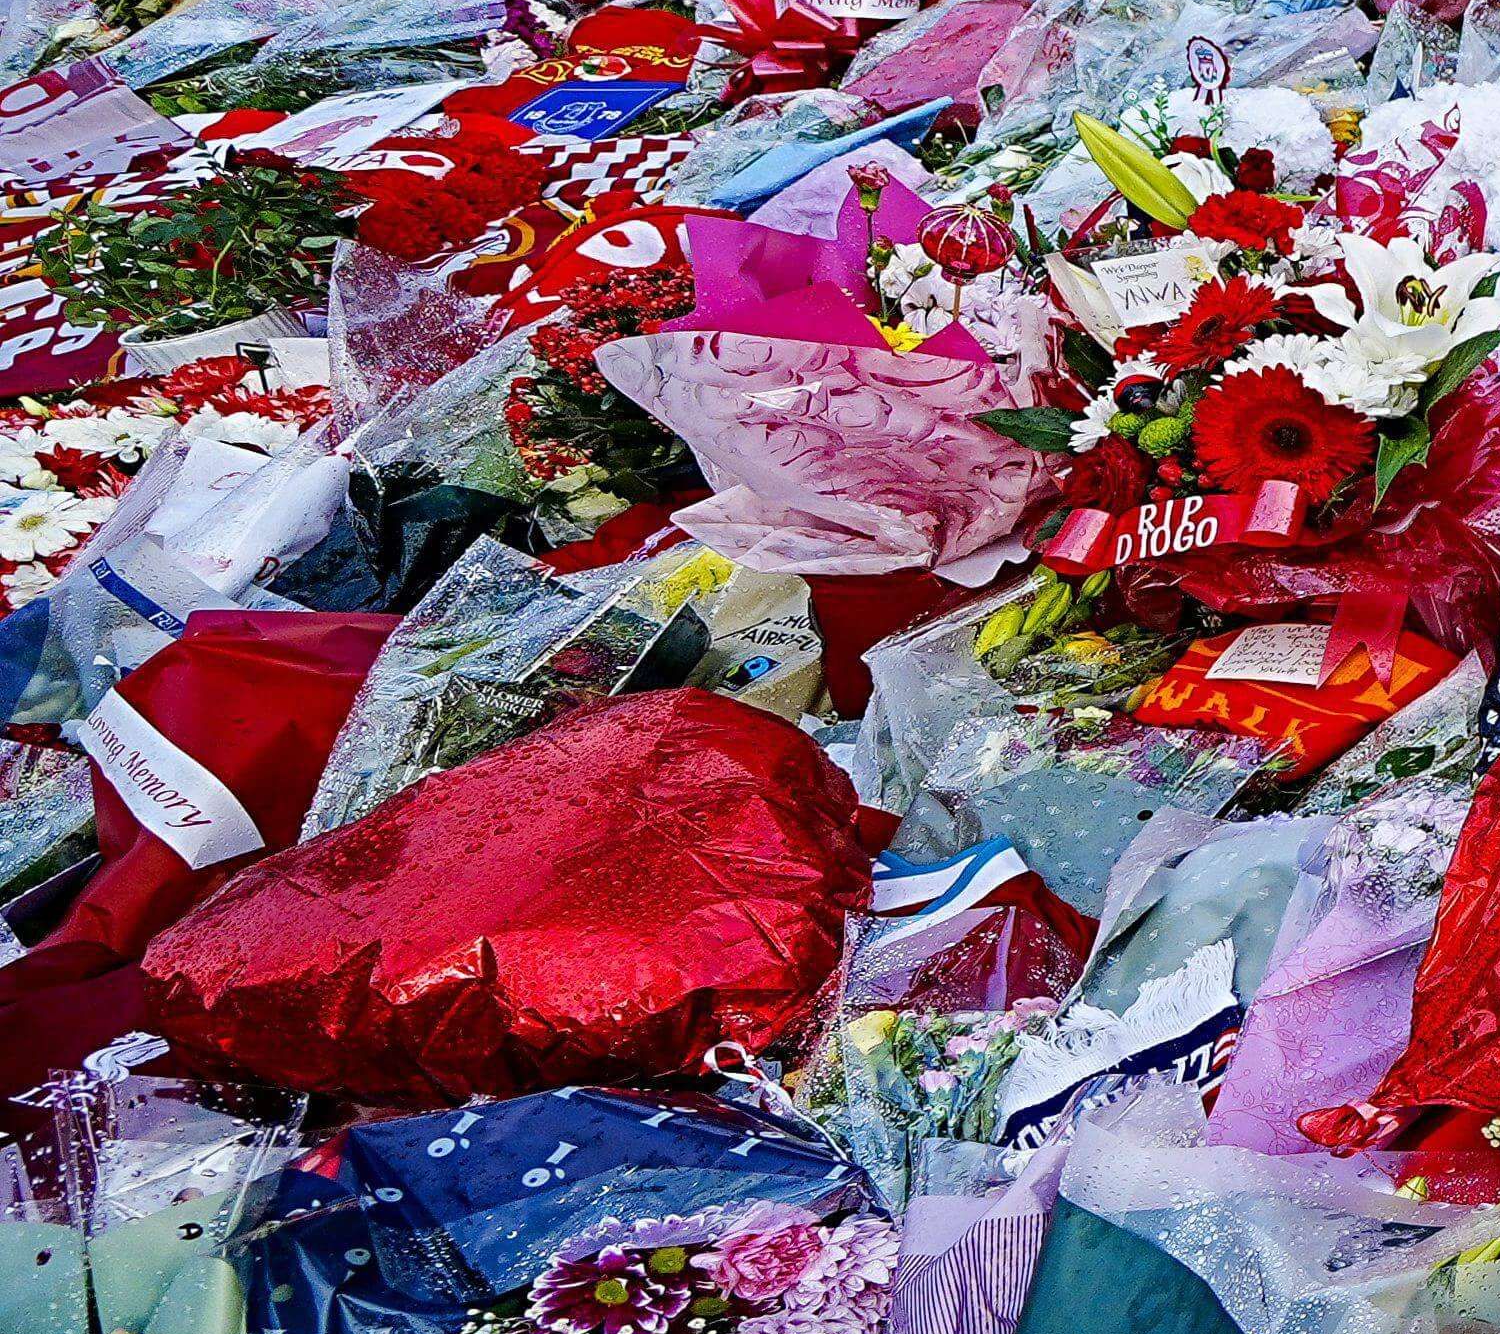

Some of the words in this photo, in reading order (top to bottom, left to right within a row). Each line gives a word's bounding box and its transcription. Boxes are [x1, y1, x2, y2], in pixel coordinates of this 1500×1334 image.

[1120, 281, 1187, 312] YNWA
[1138, 495, 1205, 536] RIP
[1116, 517, 1218, 566] DIOGO
[474, 689, 543, 720] MARKET
[484, 681, 546, 710] FLOWER
[1141, 679, 1321, 753] WALK
[122, 747, 211, 829] Memory
